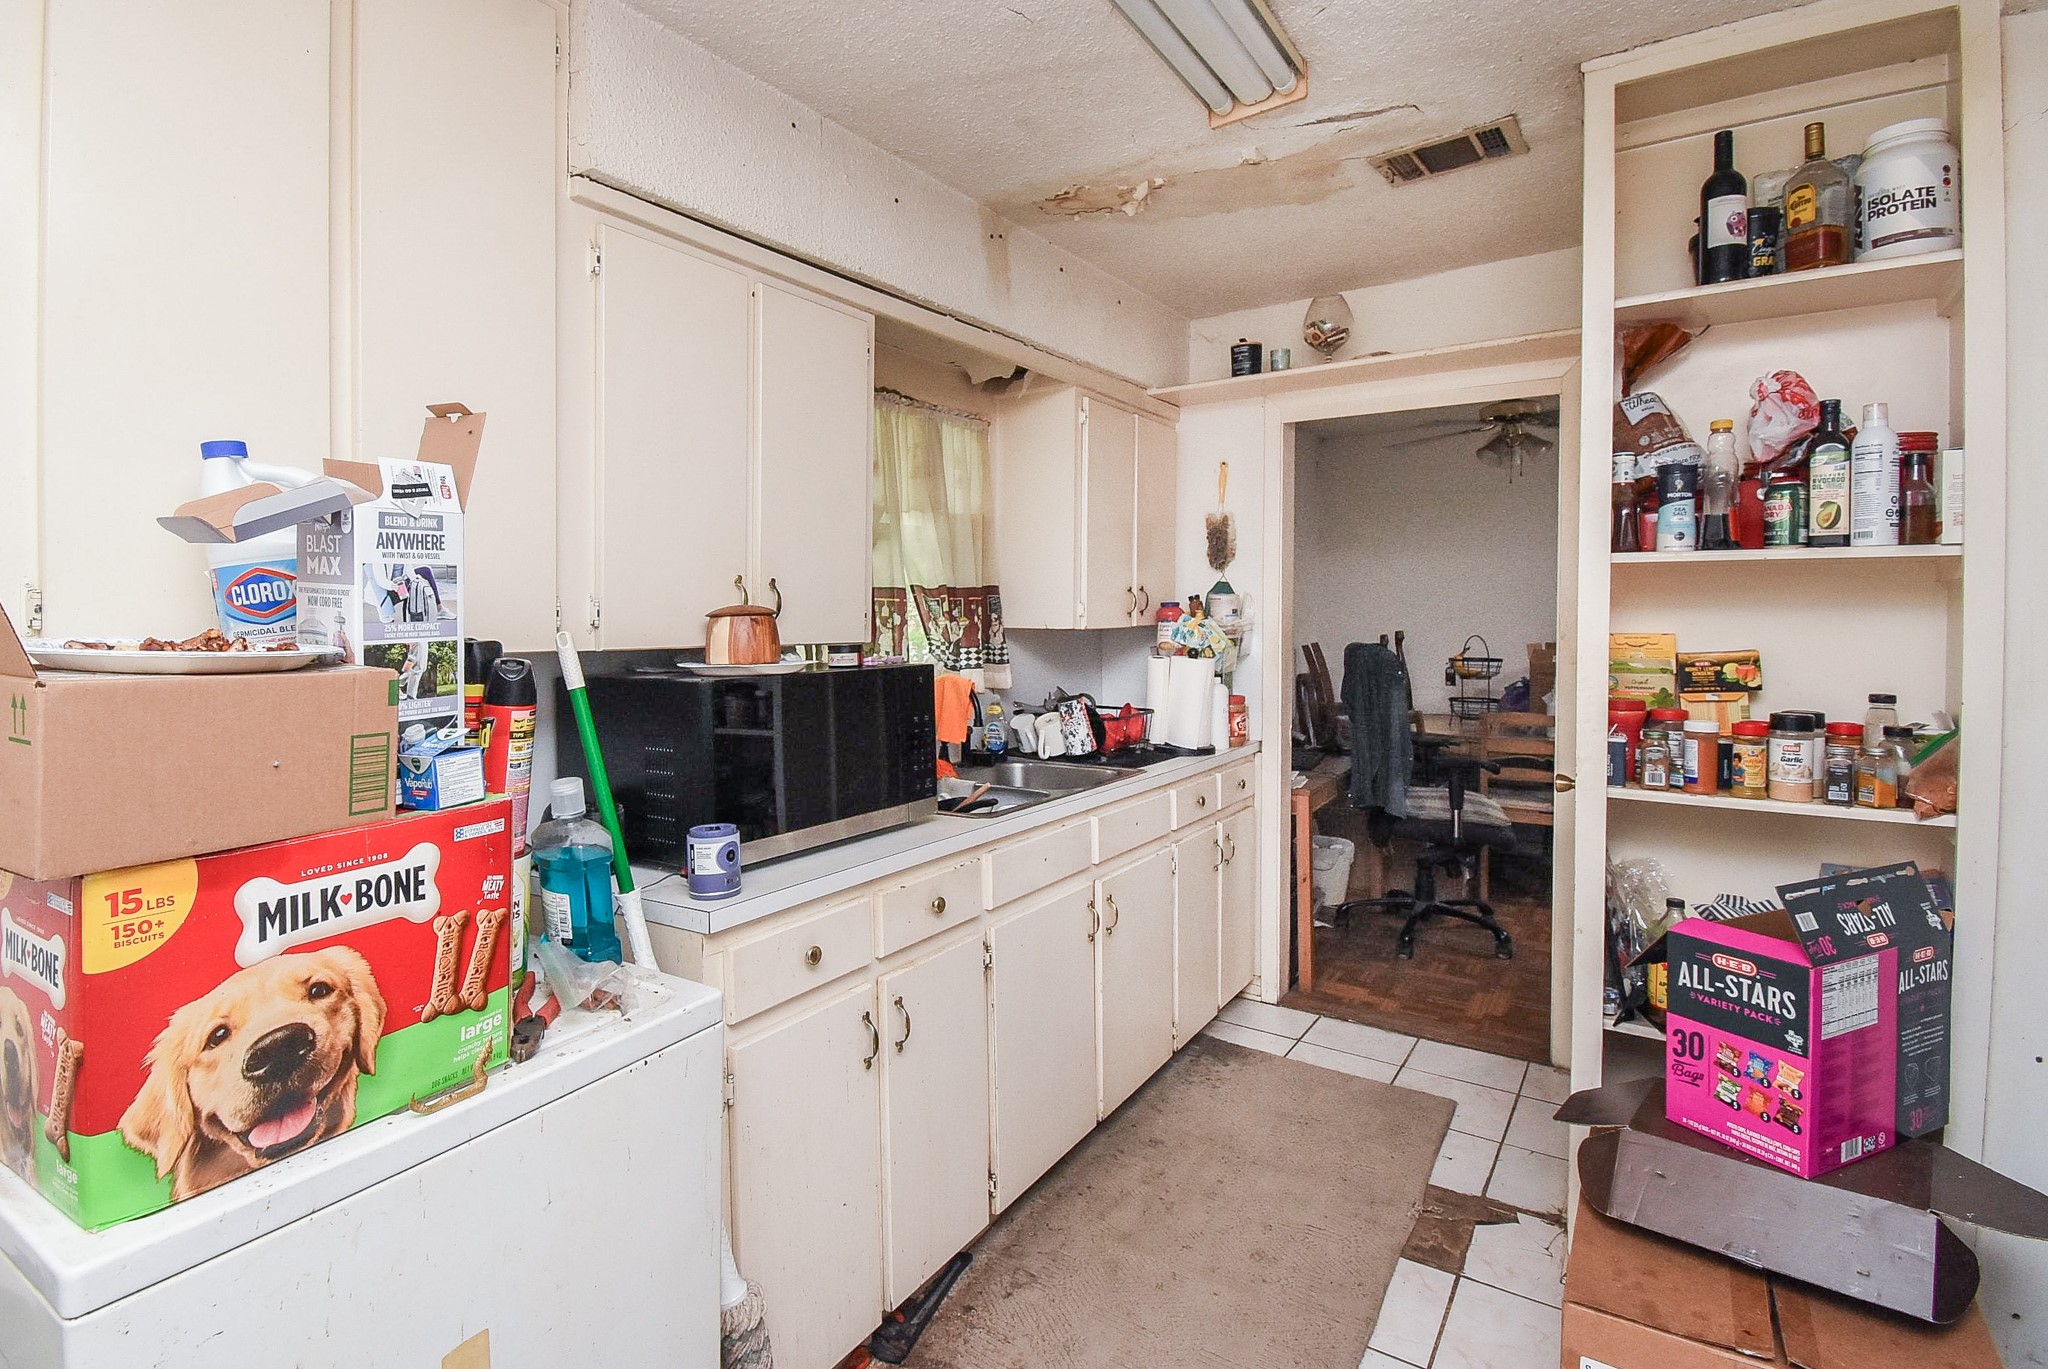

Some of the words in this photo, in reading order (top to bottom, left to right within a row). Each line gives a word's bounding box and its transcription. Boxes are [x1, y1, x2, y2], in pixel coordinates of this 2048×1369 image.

[1867, 186, 1936, 211] ISOLATE
[1867, 198, 1937, 222] PROTEIN
[1628, 397, 1656, 410] Whea
[1765, 502, 1792, 511] NADA
[384, 516, 408, 527] BLEND
[409, 518, 416, 527] &
[416, 518, 438, 529] DRINK
[306, 534, 342, 553] BLAST
[376, 532, 446, 551] ANYWHERE
[306, 556, 342, 576] MAX
[231, 580, 297, 606] CLOROX
[332, 597, 343, 608] FREE
[233, 627, 277, 637] GERMICIDAL
[279, 624, 296, 632] BLE
[416, 622, 440, 630] COMPACT
[408, 700, 431, 709] LIGHTER
[404, 777, 432, 790] VapoRub
[301, 864, 334, 877] LOVED
[336, 858, 365, 870] SINCE
[368, 852, 389, 862] 1908
[482, 880, 505, 891] MEATY
[483, 890, 500, 900] Taste
[104, 888, 144, 918] 15
[146, 895, 176, 911] LBS
[258, 884, 343, 943] MILK
[355, 864, 426, 914] BONE
[1836, 902, 1897, 936] ALL-STARS
[110, 920, 165, 940] 150+
[114, 932, 165, 949] BISCUITS
[1818, 935, 1837, 956] 30
[5, 927, 28, 968] MILK
[31, 942, 59, 990] BONE
[1716, 956, 1752, 973] H-E-B
[1898, 959, 1948, 994] ALL-STARS
[1678, 961, 1797, 1020] ALL-STARS
[1697, 992, 1740, 1014] VARIETY
[1744, 1008, 1772, 1024] PACK
[460, 1012, 502, 1042] large
[1672, 1028, 1704, 1061] 30
[453, 1052, 470, 1064] helps
[432, 1078, 441, 1088] DOG
[442, 1071, 458, 1084] SNACKS
[1672, 1063, 1705, 1082] Bags
[1910, 1108, 1923, 1132] 30
[56, 1159, 78, 1184] large
